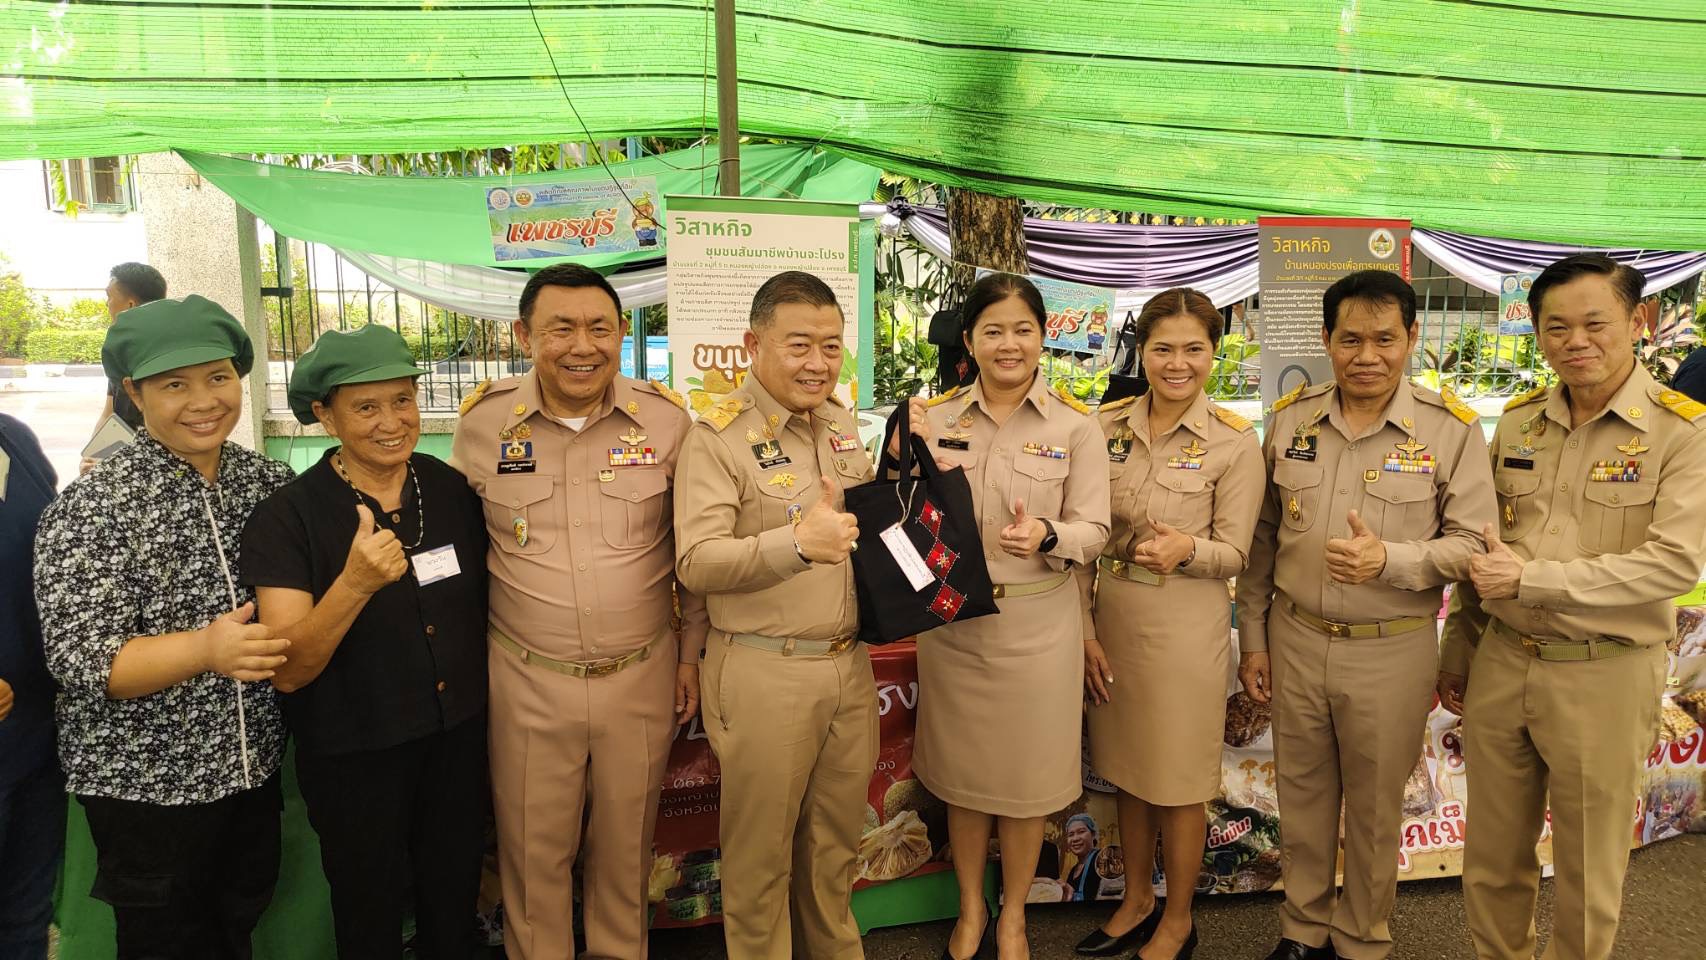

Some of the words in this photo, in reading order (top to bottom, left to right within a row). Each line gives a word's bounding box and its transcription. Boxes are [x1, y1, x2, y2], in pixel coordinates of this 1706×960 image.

[507, 207, 619, 248] เพชรบุรี
[675, 216, 752, 237] วิสาหกิจ
[1271, 236, 1331, 254] วิสาหกิจ
